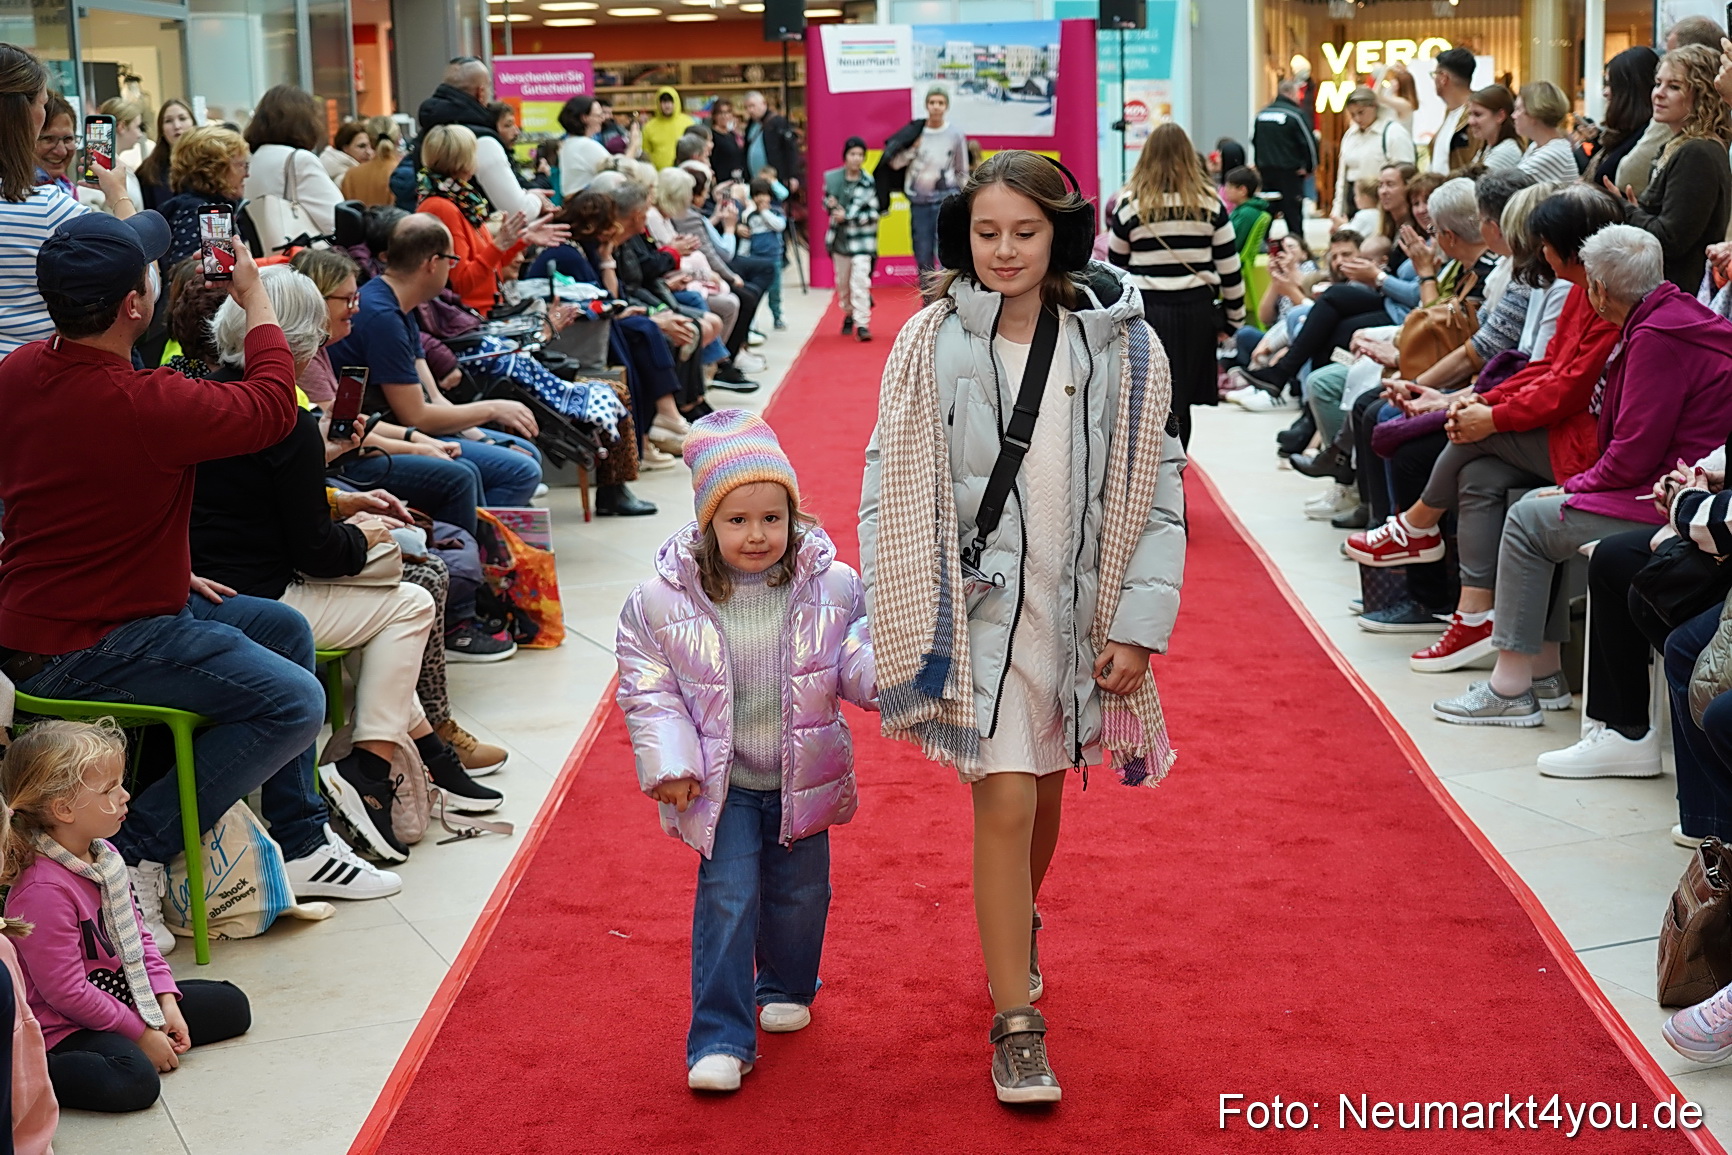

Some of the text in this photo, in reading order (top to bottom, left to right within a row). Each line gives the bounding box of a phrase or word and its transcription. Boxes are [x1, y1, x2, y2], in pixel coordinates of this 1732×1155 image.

[498, 70, 585, 84] Verschenken Sie
[521, 83, 585, 95] Gutscheine!
[218, 877, 249, 899] shock
[209, 885, 257, 918] absorbers
